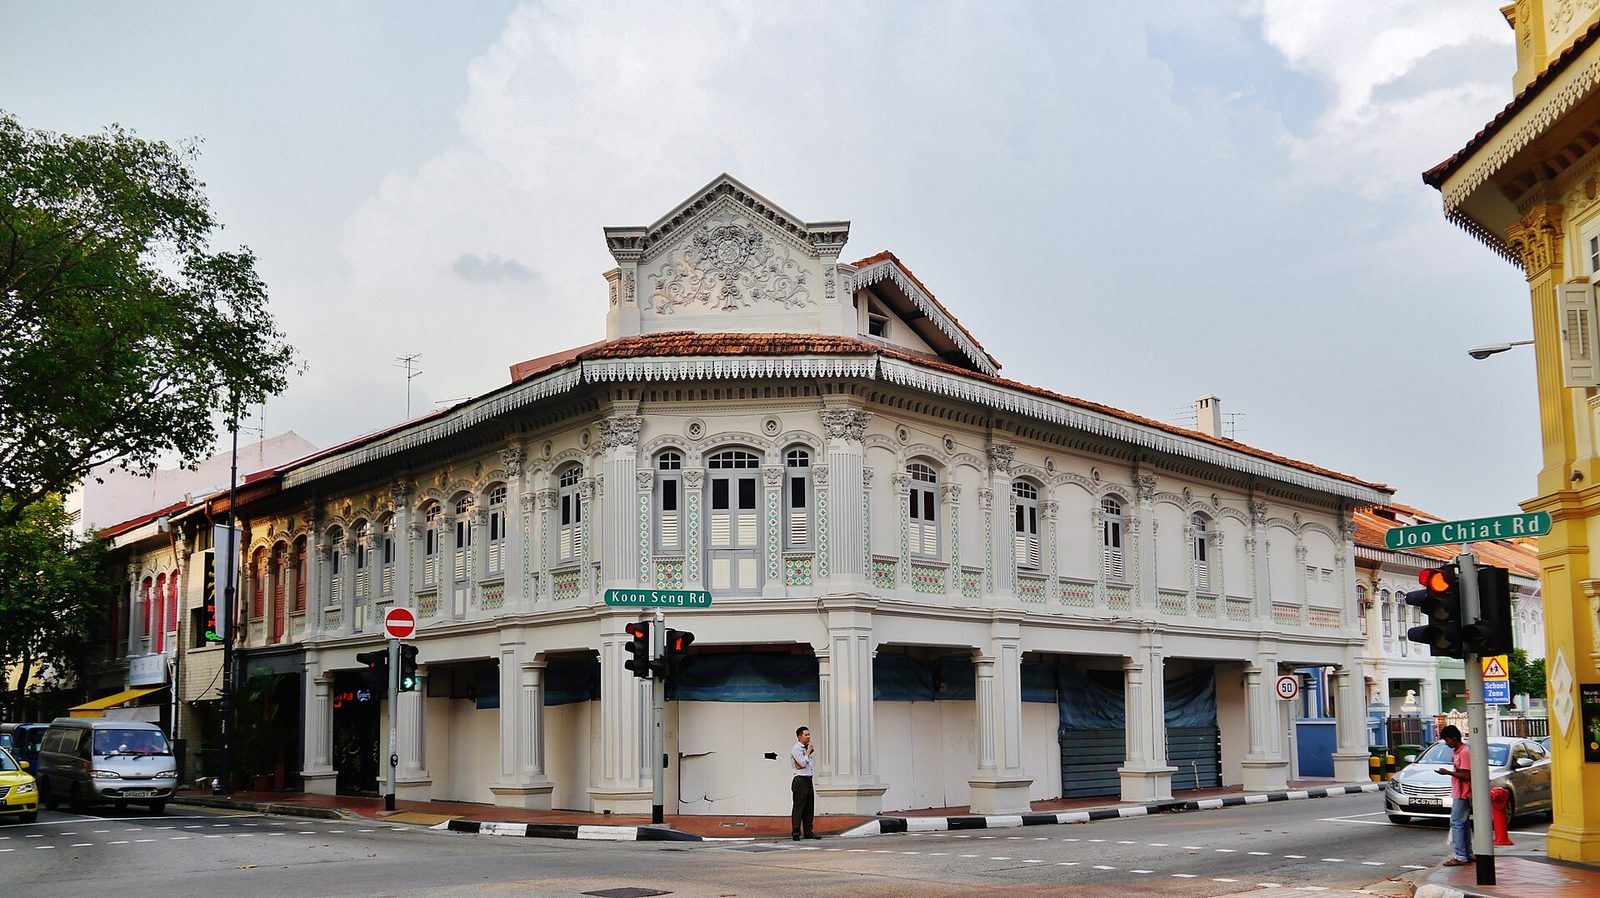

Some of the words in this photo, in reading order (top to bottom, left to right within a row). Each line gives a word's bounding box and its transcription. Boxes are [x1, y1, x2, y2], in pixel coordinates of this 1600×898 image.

[1396, 530, 1431, 546] Joo
[1442, 521, 1501, 541] Chiat
[1513, 515, 1540, 534] Rd
[612, 590, 645, 603] Koon
[651, 591, 684, 606] Seng
[689, 592, 705, 604] Rd
[1281, 683, 1293, 693] 50
